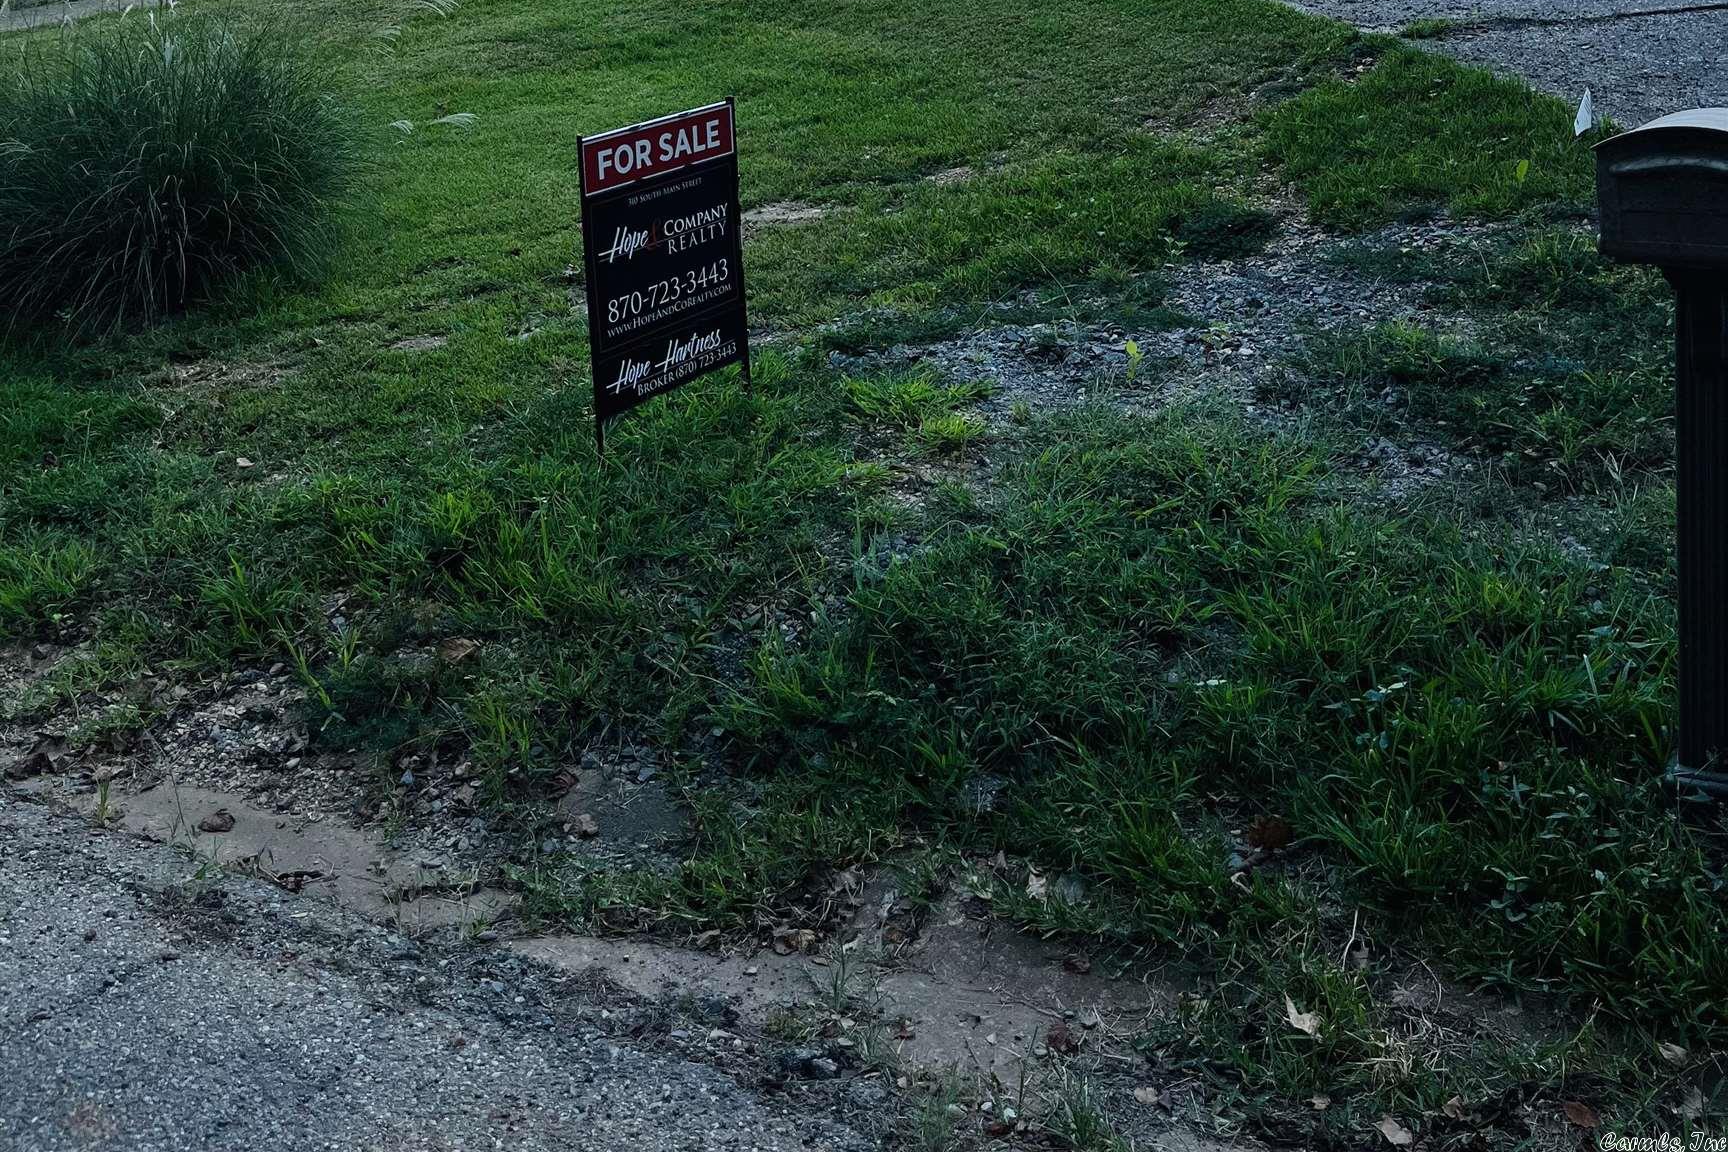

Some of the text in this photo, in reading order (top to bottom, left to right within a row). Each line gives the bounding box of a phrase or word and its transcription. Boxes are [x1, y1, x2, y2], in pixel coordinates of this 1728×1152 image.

[597, 119, 721, 180] FOR SALE
[598, 226, 649, 263] Hope
[664, 202, 728, 237] COMPANY
[668, 220, 728, 255] REALTY
[608, 258, 729, 323] 870-723-3443
[606, 329, 720, 394] Hope Hartness
[637, 371, 676, 396] BROKER
